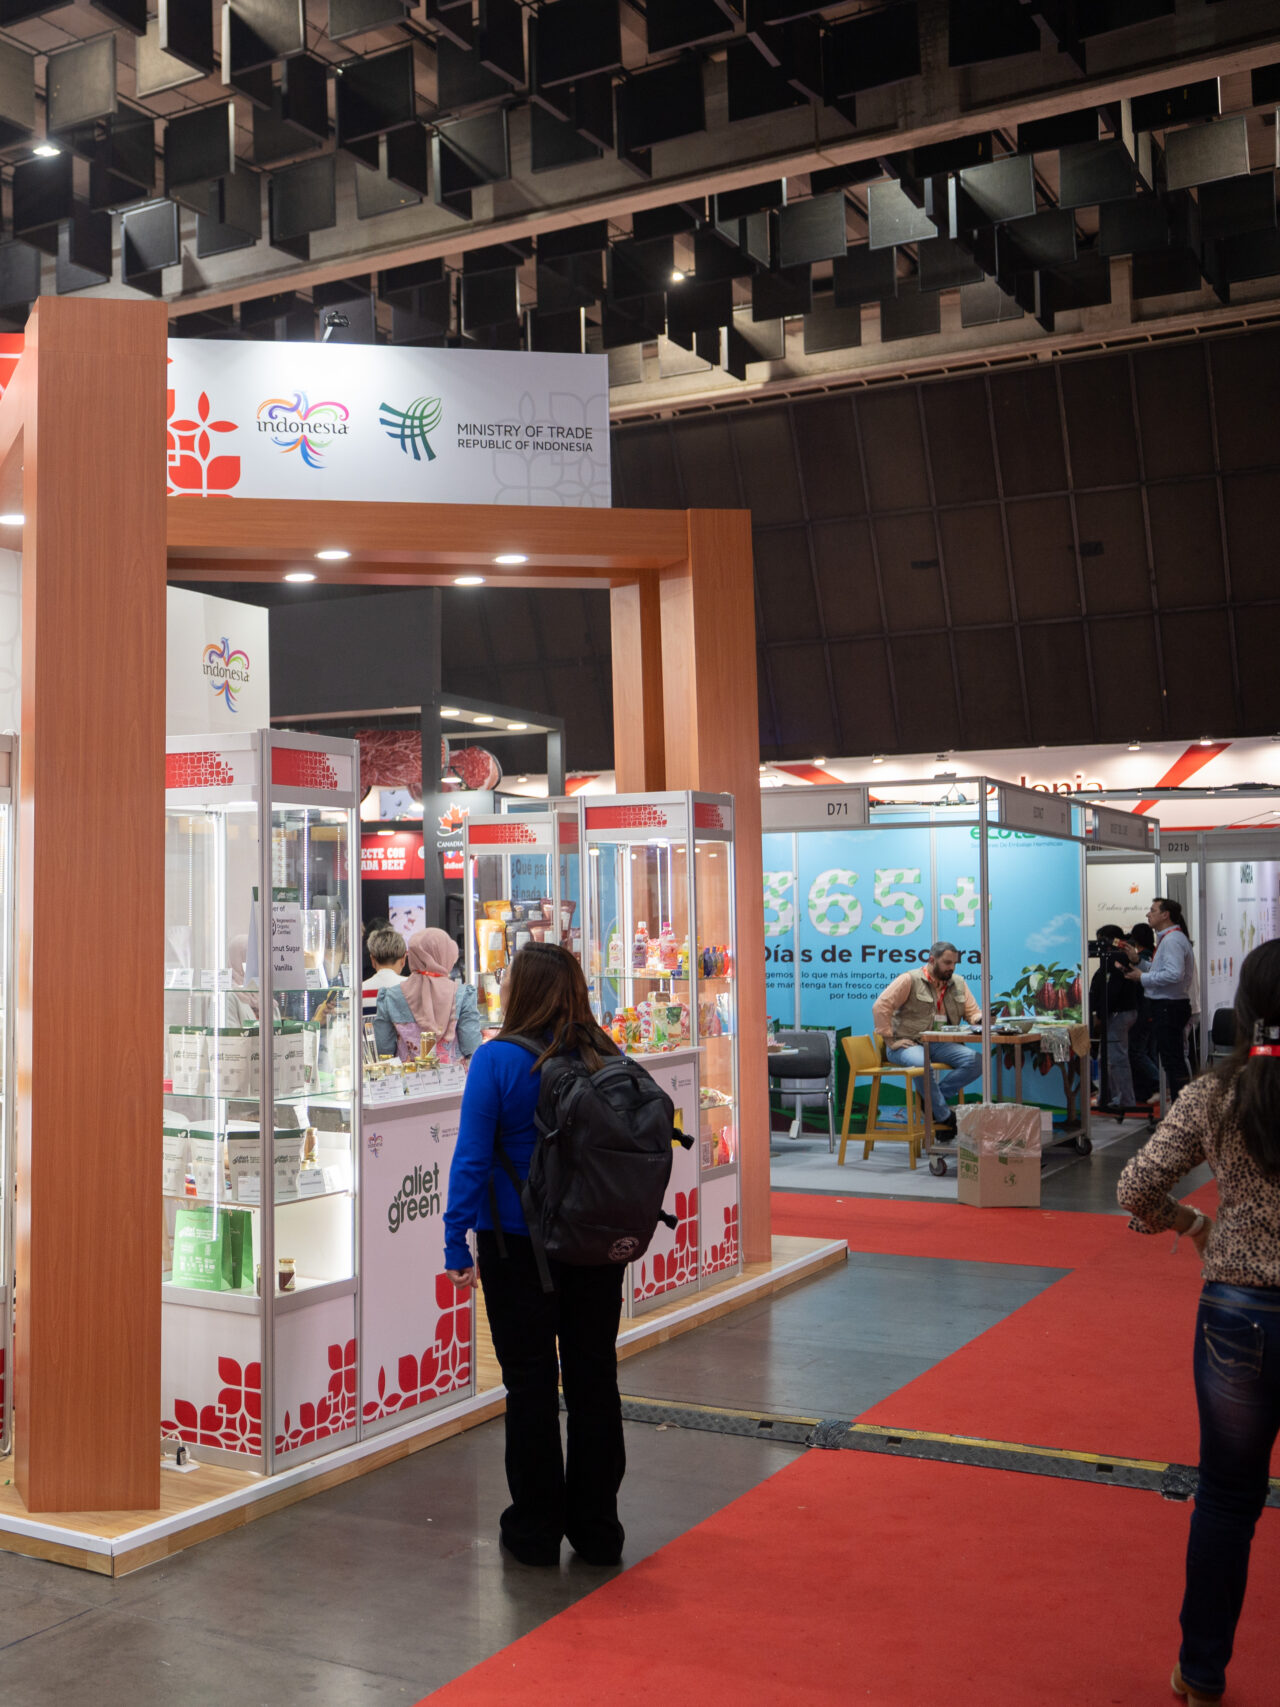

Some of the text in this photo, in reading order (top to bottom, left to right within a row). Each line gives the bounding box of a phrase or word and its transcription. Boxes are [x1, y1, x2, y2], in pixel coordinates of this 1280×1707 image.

[256, 417, 350, 435] indonesia
[457, 423, 593, 439] MINISTRY OF TRADE
[457, 438, 593, 452] REPUBLIC OF INDONESIA
[202, 661, 250, 682] indonesia
[827, 802, 848, 816] D71
[387, 847, 406, 859] CON
[1168, 842, 1190, 853] D21b
[381, 859, 406, 871] BEEF
[821, 944, 853, 963] de
[861, 944, 981, 965] Frescra
[273, 964, 293, 972] Vanilla
[810, 972, 828, 982] que
[830, 969, 849, 980] más
[850, 970, 888, 982] importa,
[829, 981, 843, 989] tan
[845, 980, 873, 990] fresco
[829, 992, 845, 1001] por
[846, 990, 868, 1000] todo
[402, 1161, 440, 1198] aliet
[387, 1192, 440, 1234] green
